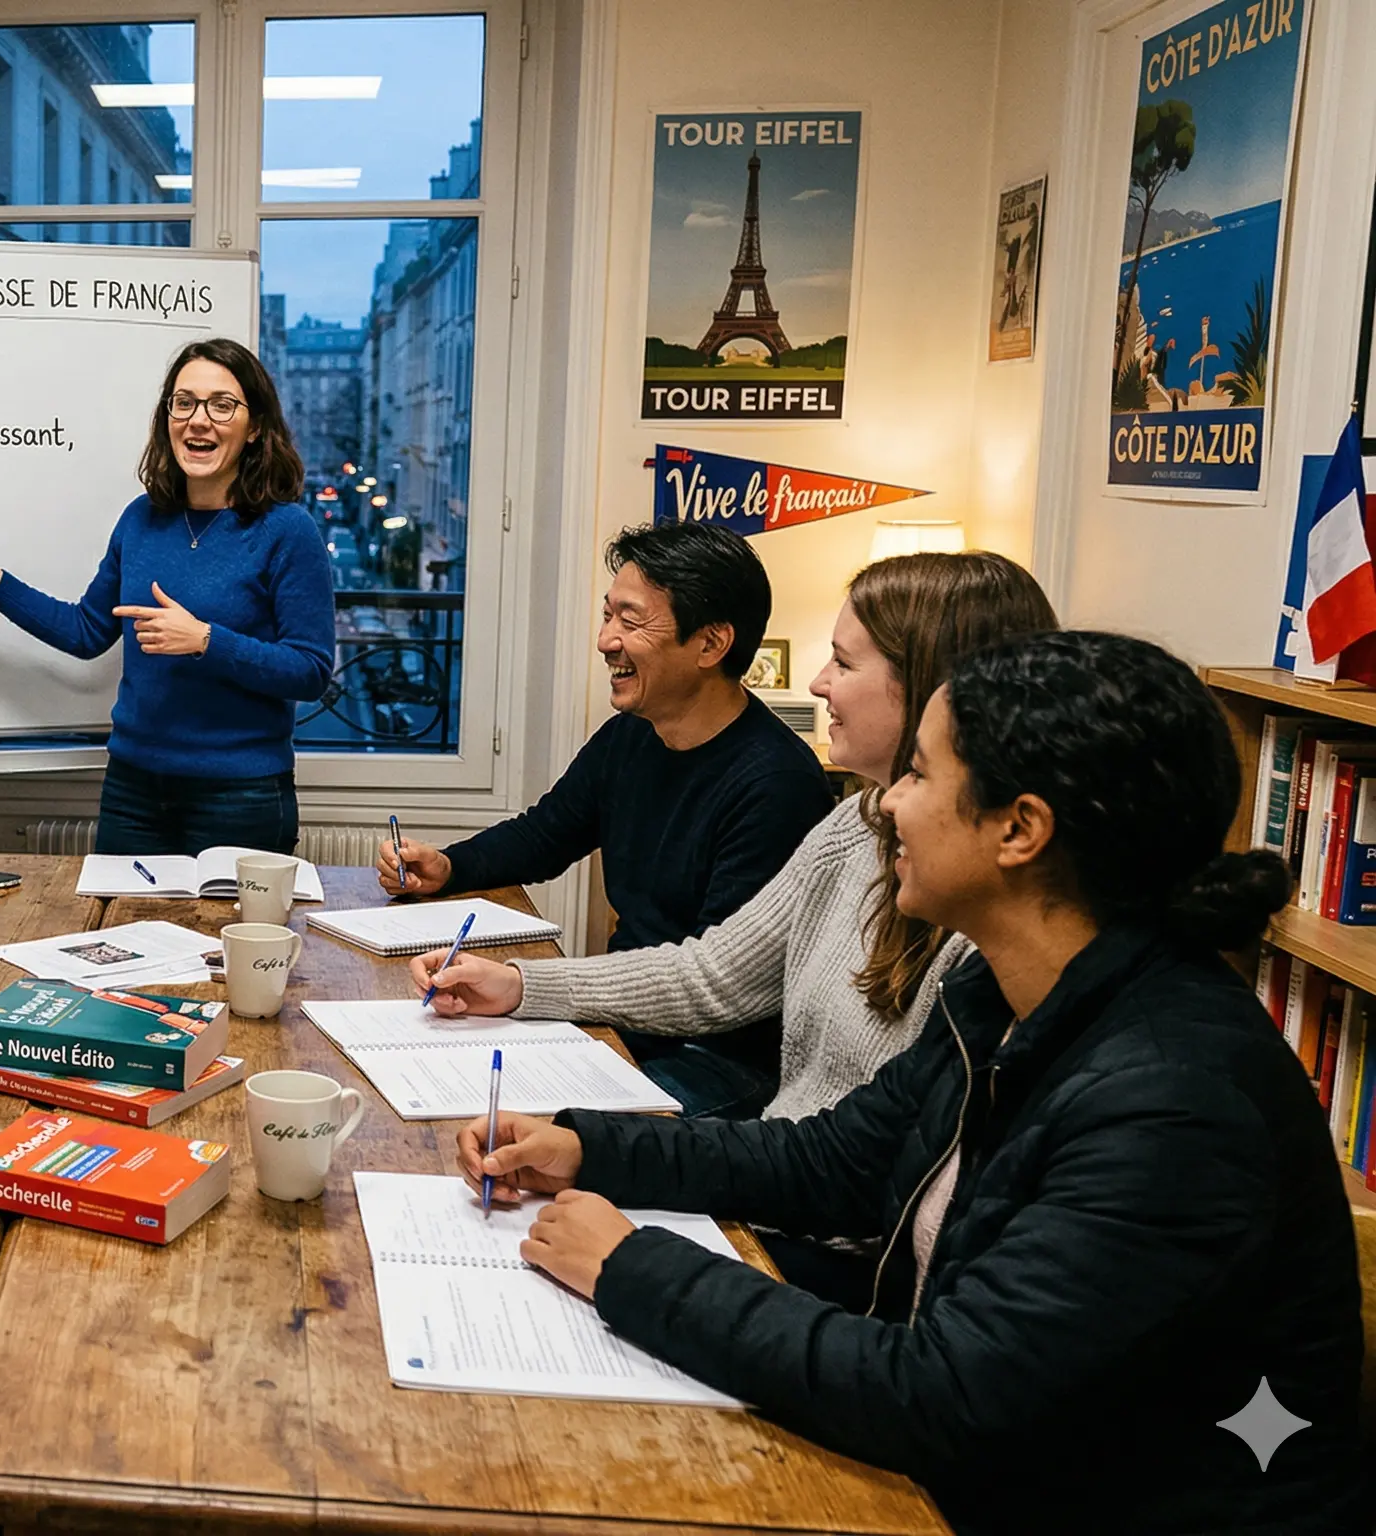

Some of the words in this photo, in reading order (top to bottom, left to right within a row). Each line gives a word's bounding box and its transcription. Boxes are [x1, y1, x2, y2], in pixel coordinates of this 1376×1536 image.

[1146, 33, 1202, 93] CÔTE
[1207, 0, 1295, 68] D'AZUR
[663, 122, 745, 147] TOUR
[755, 120, 853, 146] EIFFEL
[50, 280, 78, 308] DE
[93, 280, 214, 320] FRANÇAIS
[650, 387, 731, 411] TOUR
[740, 387, 836, 411] EIFFEL
[1114, 414, 1169, 463] CÔTE
[1173, 423, 1257, 465] D'AZUR
[666, 462, 737, 522] Vive
[744, 470, 770, 518] le
[770, 473, 878, 524] français!
[8, 1039, 67, 1064] Nouvel
[71, 1043, 115, 1070] Édito
[263, 1122, 297, 1142] Café
